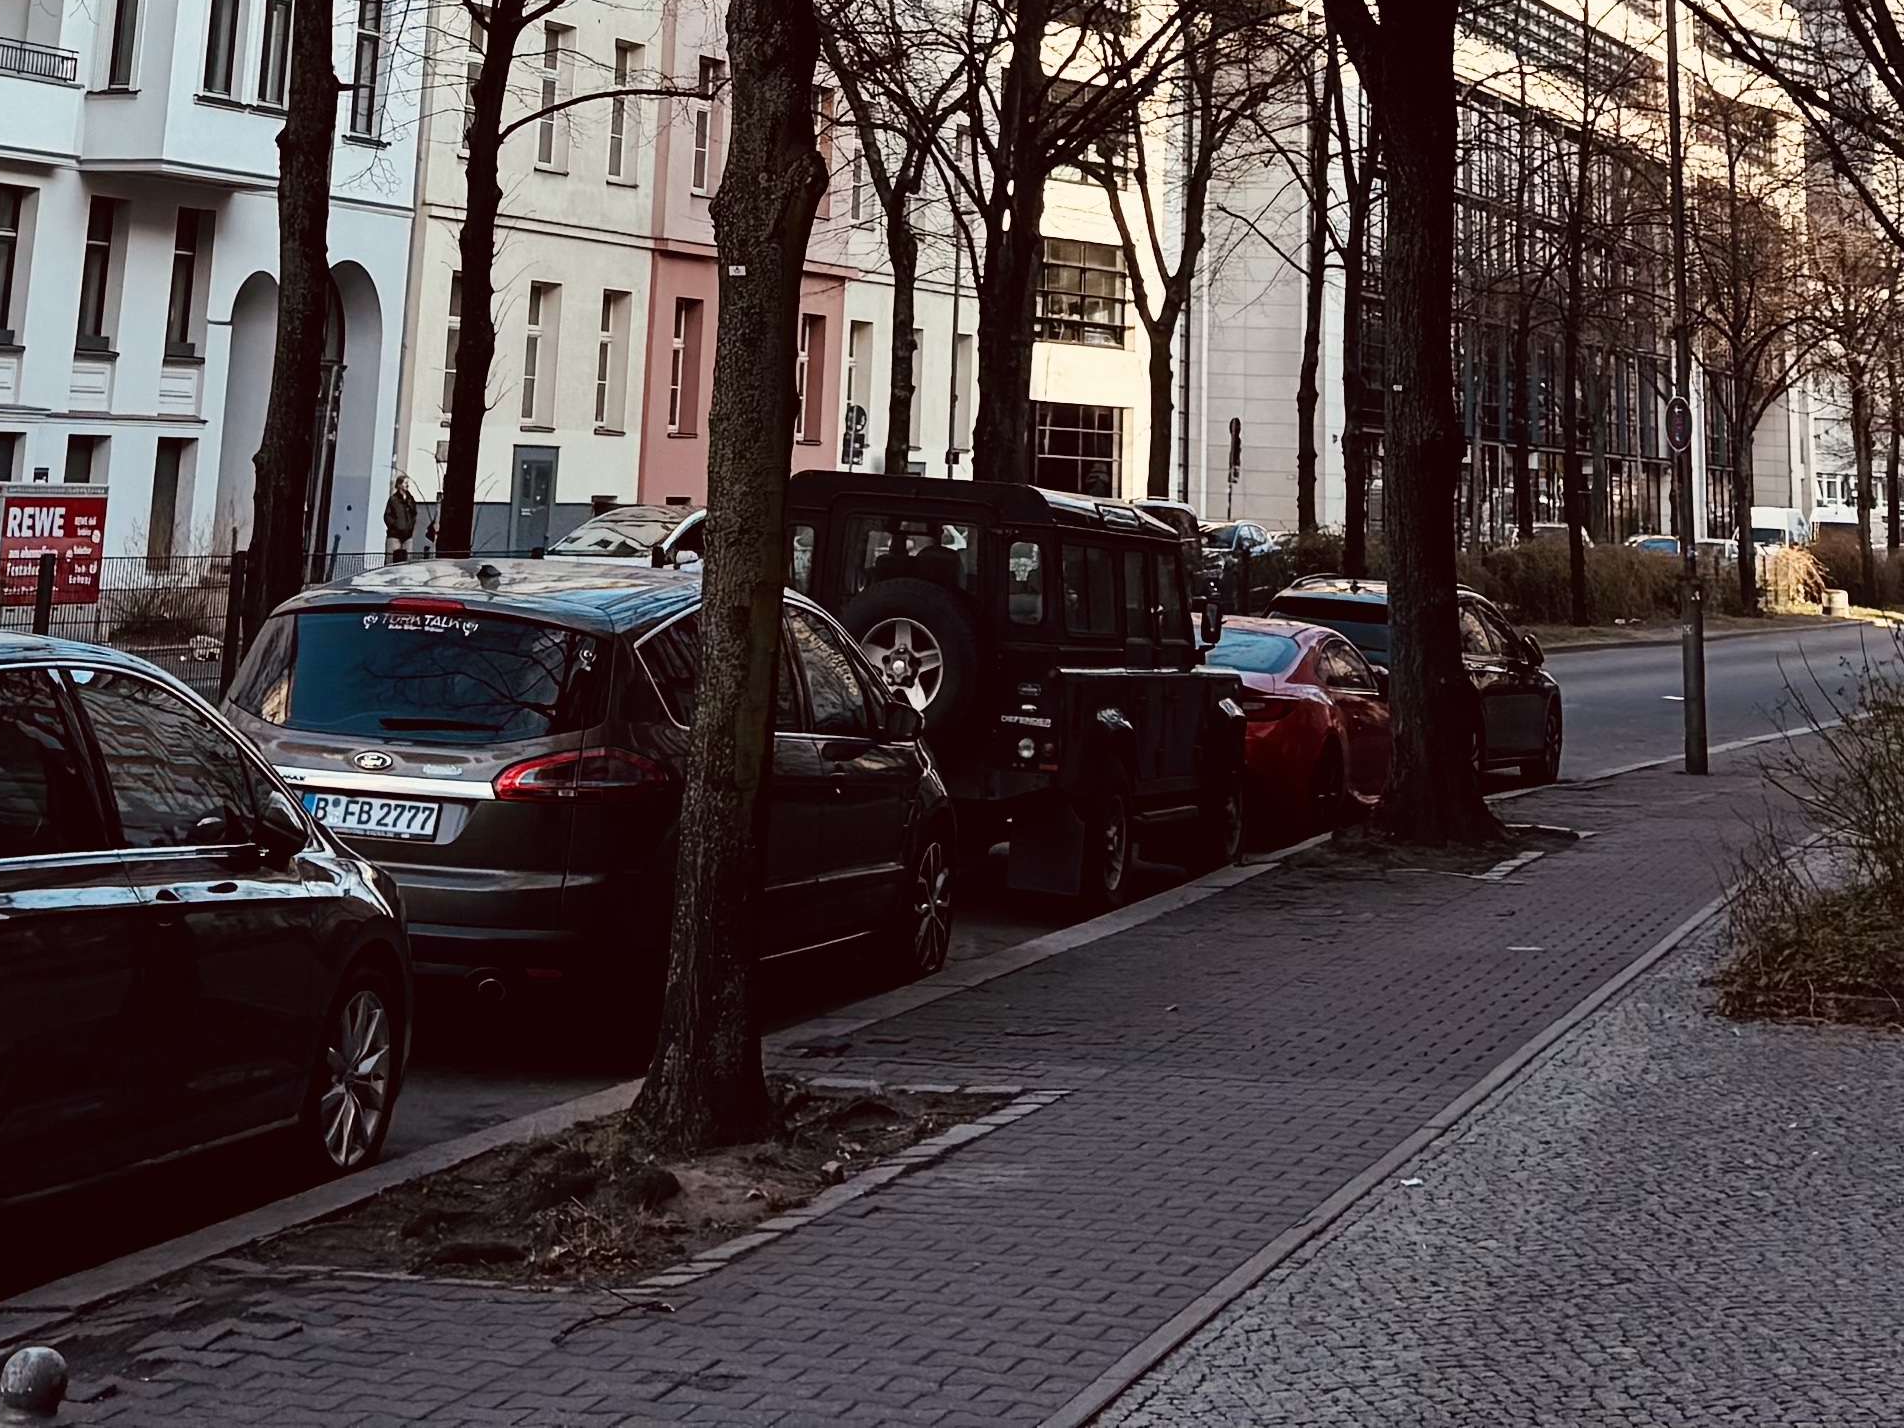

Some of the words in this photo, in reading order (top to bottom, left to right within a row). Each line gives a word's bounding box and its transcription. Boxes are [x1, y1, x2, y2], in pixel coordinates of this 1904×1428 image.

[6, 506, 67, 538] REWE
[313, 797, 330, 822] B
[342, 799, 375, 826] FB
[376, 802, 436, 832] 2777
